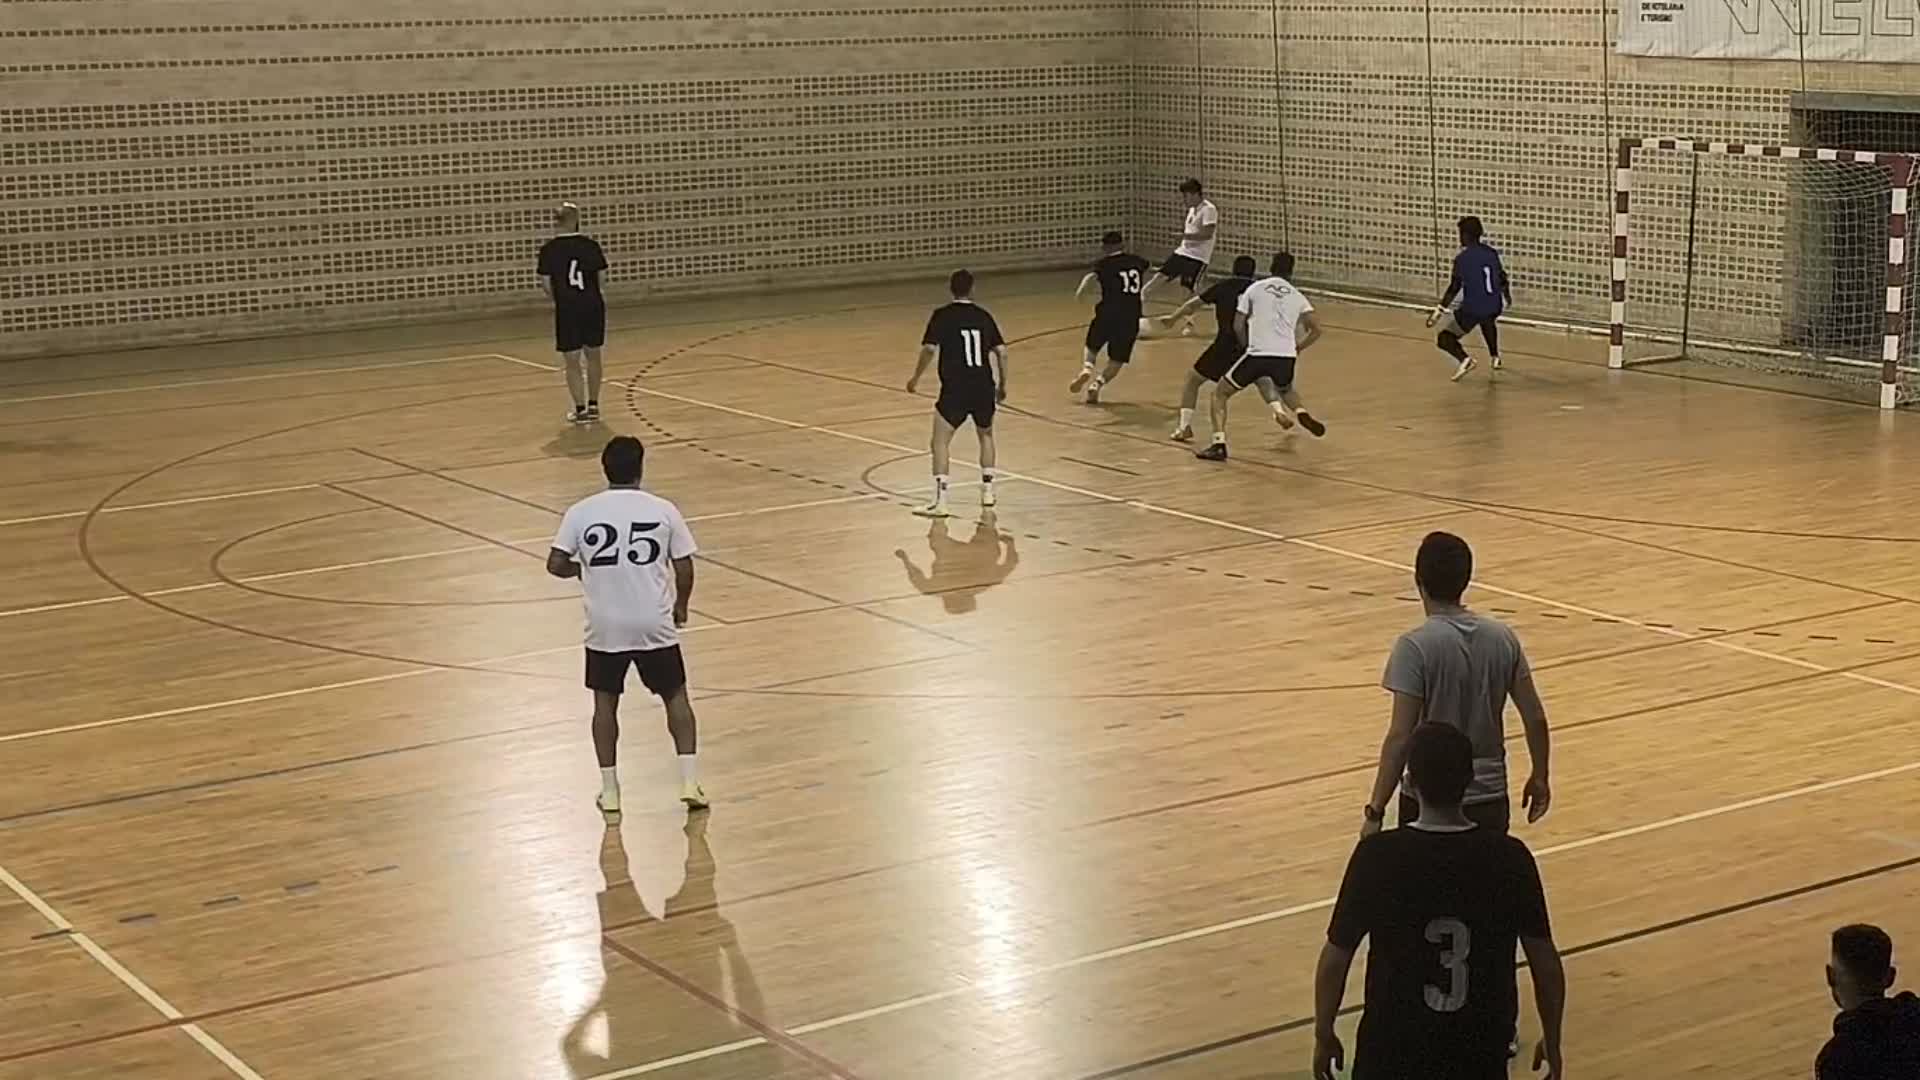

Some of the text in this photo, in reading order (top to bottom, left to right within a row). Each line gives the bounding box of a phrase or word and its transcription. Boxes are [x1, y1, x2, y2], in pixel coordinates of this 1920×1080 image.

[569, 259, 584, 290] 4
[1119, 269, 1140, 294] 13
[1483, 266, 1493, 293] 1
[960, 329, 982, 367] 11
[583, 522, 661, 567] 25
[1424, 919, 1470, 1012] 3
